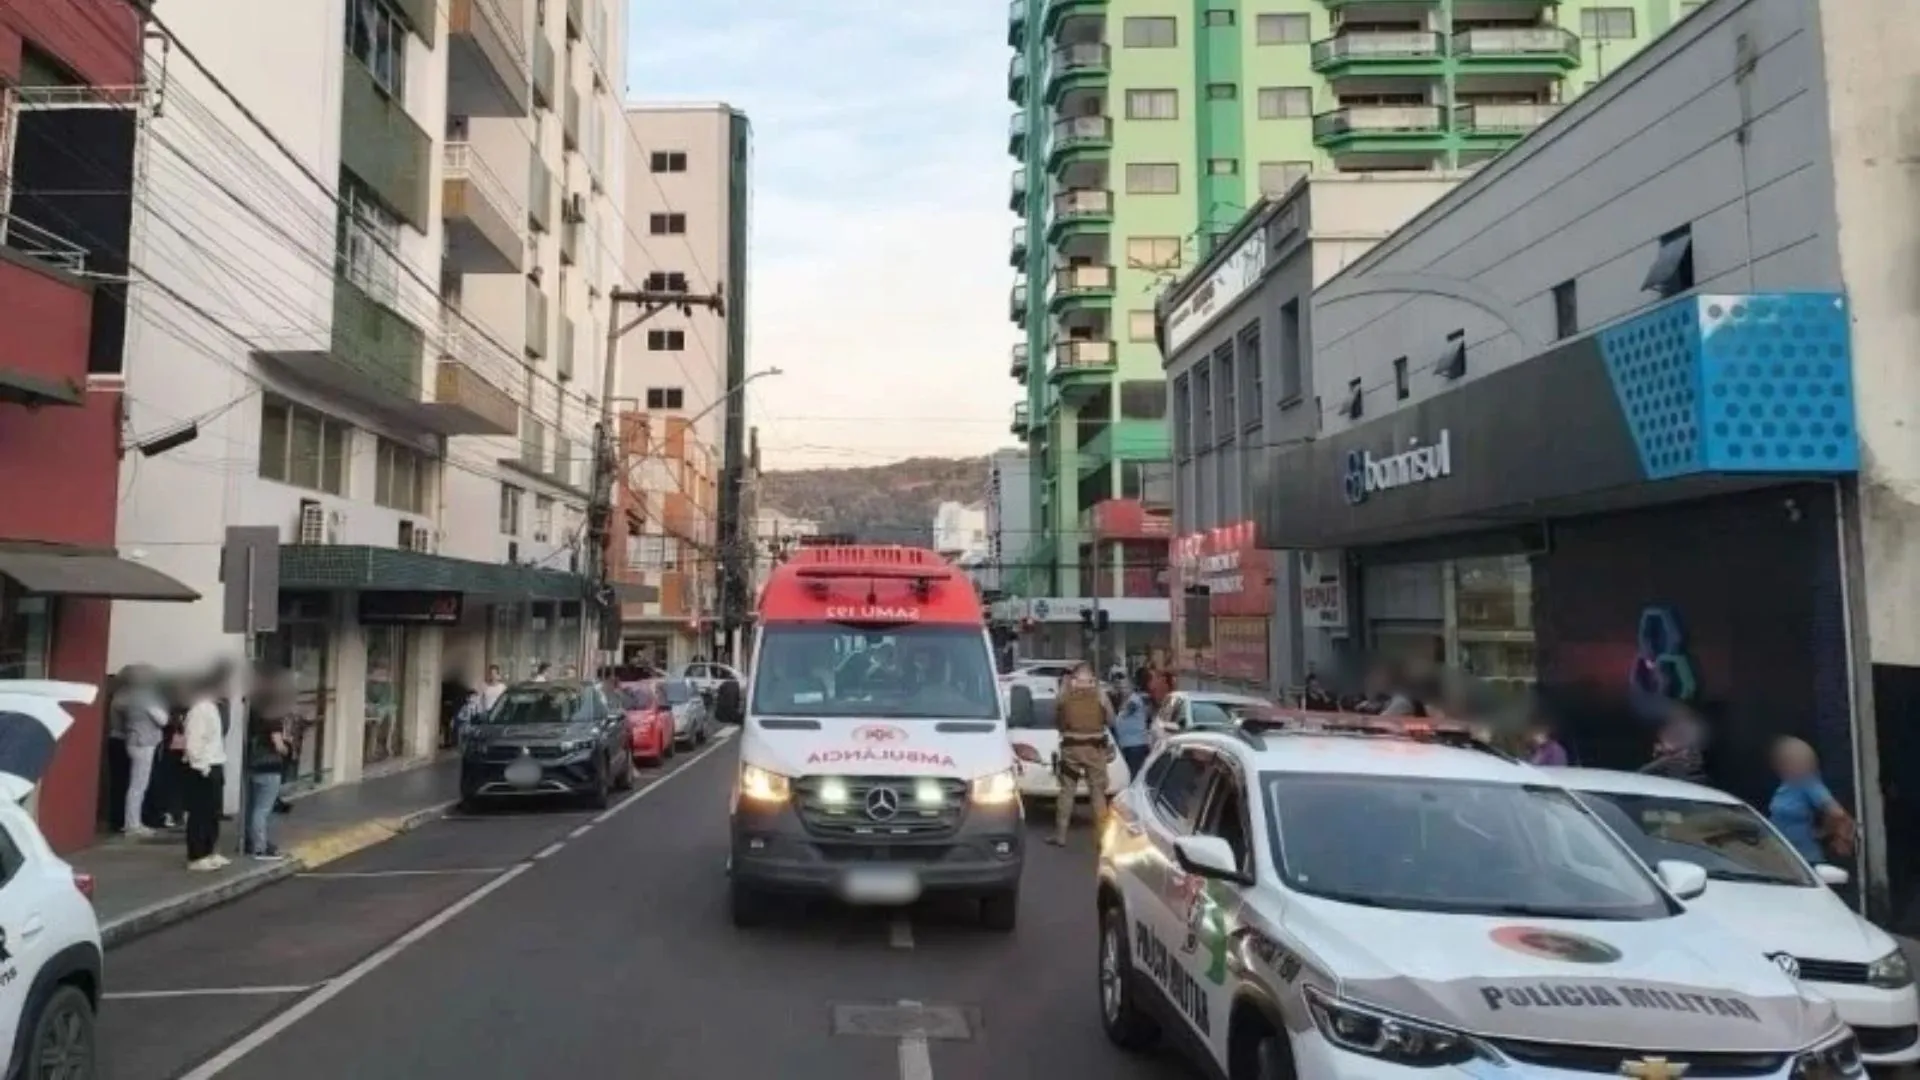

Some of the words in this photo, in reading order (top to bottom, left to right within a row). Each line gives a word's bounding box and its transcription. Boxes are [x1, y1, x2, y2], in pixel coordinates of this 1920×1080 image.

[1364, 428, 1450, 492] banrisul
[1479, 980, 1621, 1011] POLÍCIA
[1614, 984, 1762, 1023] MILITAR
